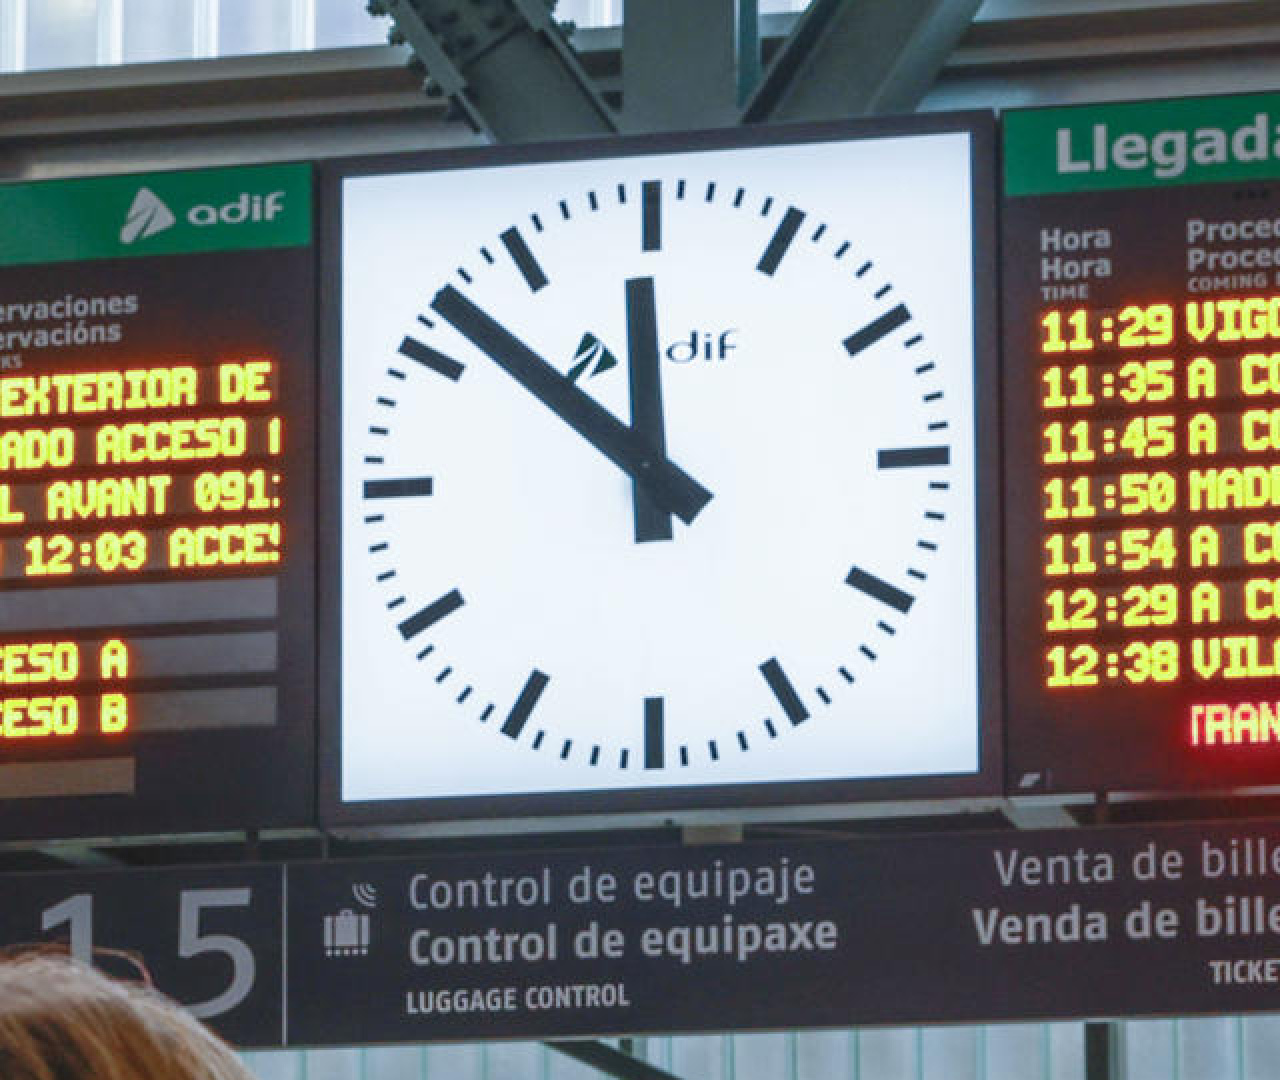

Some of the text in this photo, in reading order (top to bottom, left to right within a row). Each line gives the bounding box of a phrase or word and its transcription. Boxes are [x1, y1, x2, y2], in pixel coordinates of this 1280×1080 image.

[187, 192, 284, 225] adif
[1040, 228, 1111, 252] Hora
[1041, 257, 1111, 281] Hora
[1187, 272, 1268, 292] COMING
[1040, 284, 1088, 301] TIME
[666, 329, 739, 364] dif
[1042, 304, 1172, 352] 11:29
[0, 366, 196, 416] EXTERIOR
[220, 362, 270, 402] DE
[1044, 360, 1174, 408] 11:35
[1188, 358, 1216, 398] A
[96, 418, 246, 464] ACCESO
[1044, 416, 1174, 464] 11:45
[1188, 414, 1216, 454] A
[48, 476, 172, 520] AVANT
[1044, 472, 1176, 518] 11:50
[26, 530, 146, 575] 12:03
[102, 640, 128, 678] A
[1048, 640, 1178, 686] 12:38
[100, 694, 128, 732] B
[410, 858, 814, 910] Control de equipaje
[994, 848, 1113, 886] Venta
[1133, 842, 1183, 880] de
[410, 914, 837, 965] Control de equipaxe
[972, 904, 1107, 945] Venda
[1126, 901, 1178, 939] de
[179, 888, 256, 1020] 5
[407, 984, 630, 1014] LUGGAGE CONTROL
